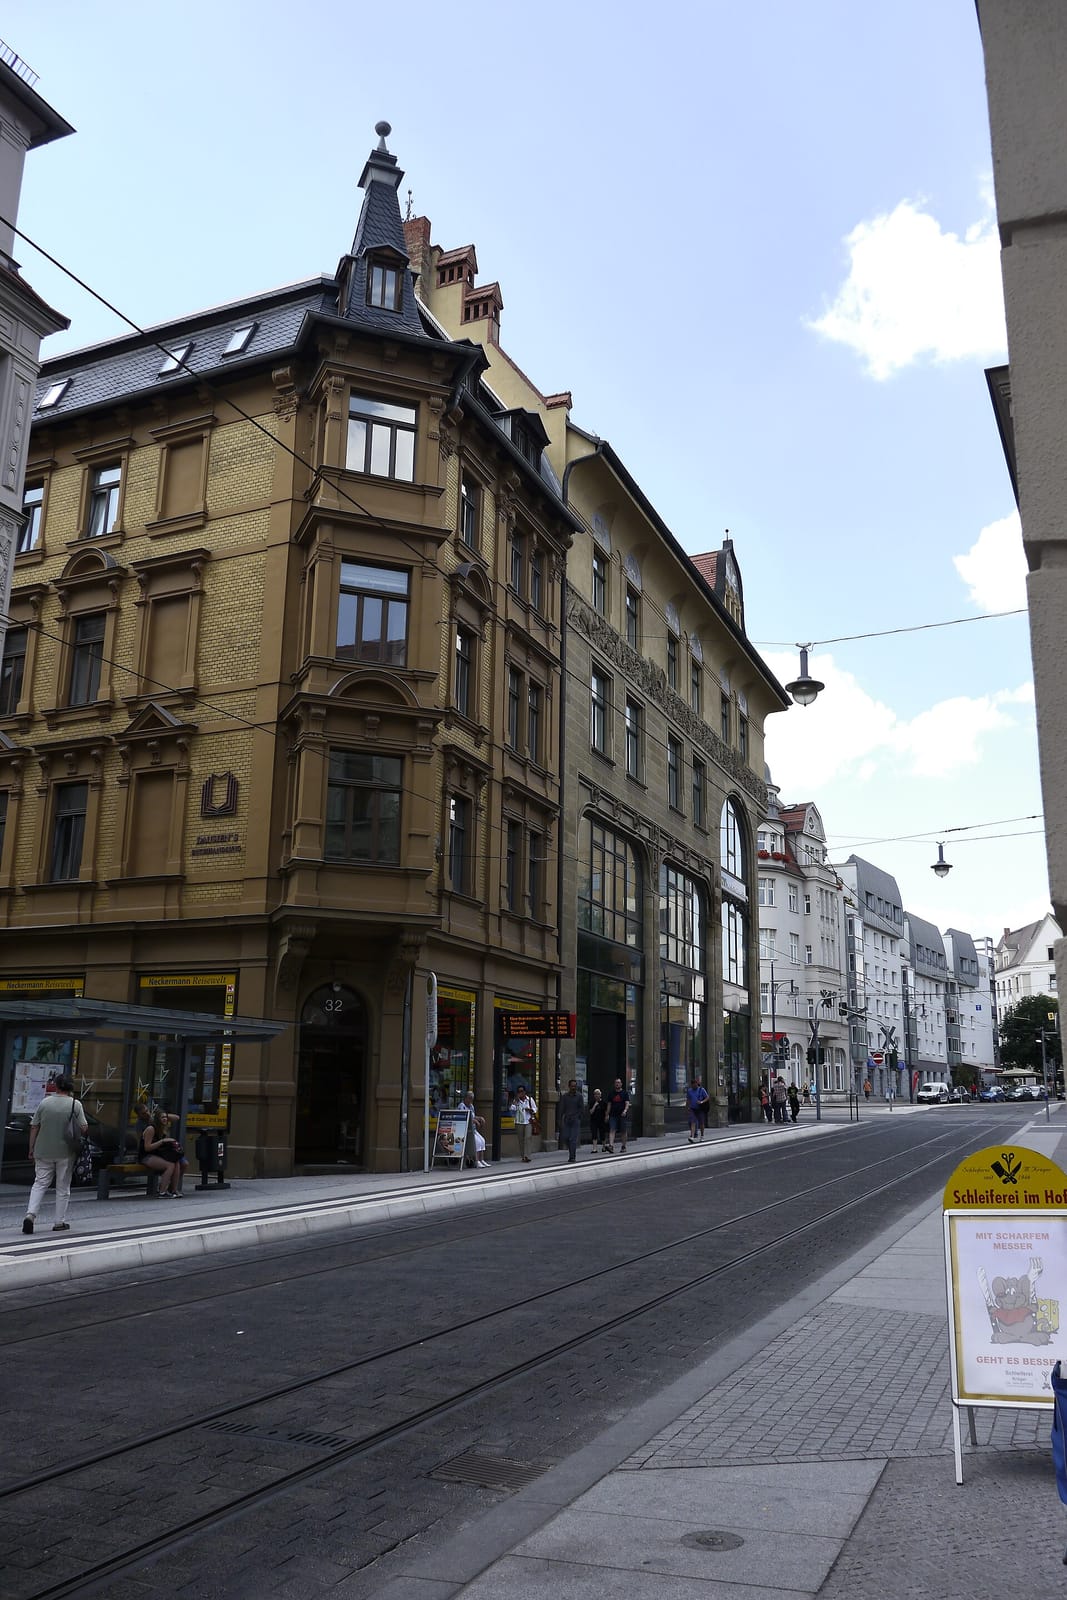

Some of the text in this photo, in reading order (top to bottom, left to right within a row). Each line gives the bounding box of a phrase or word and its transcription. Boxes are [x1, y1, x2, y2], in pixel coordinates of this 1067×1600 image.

[148, 977, 191, 986] Neckermann
[325, 999, 343, 1012] 32
[954, 1189, 1067, 1204] Schleiferei im Hof
[977, 1356, 1057, 1366] GEHT ES BESSE
